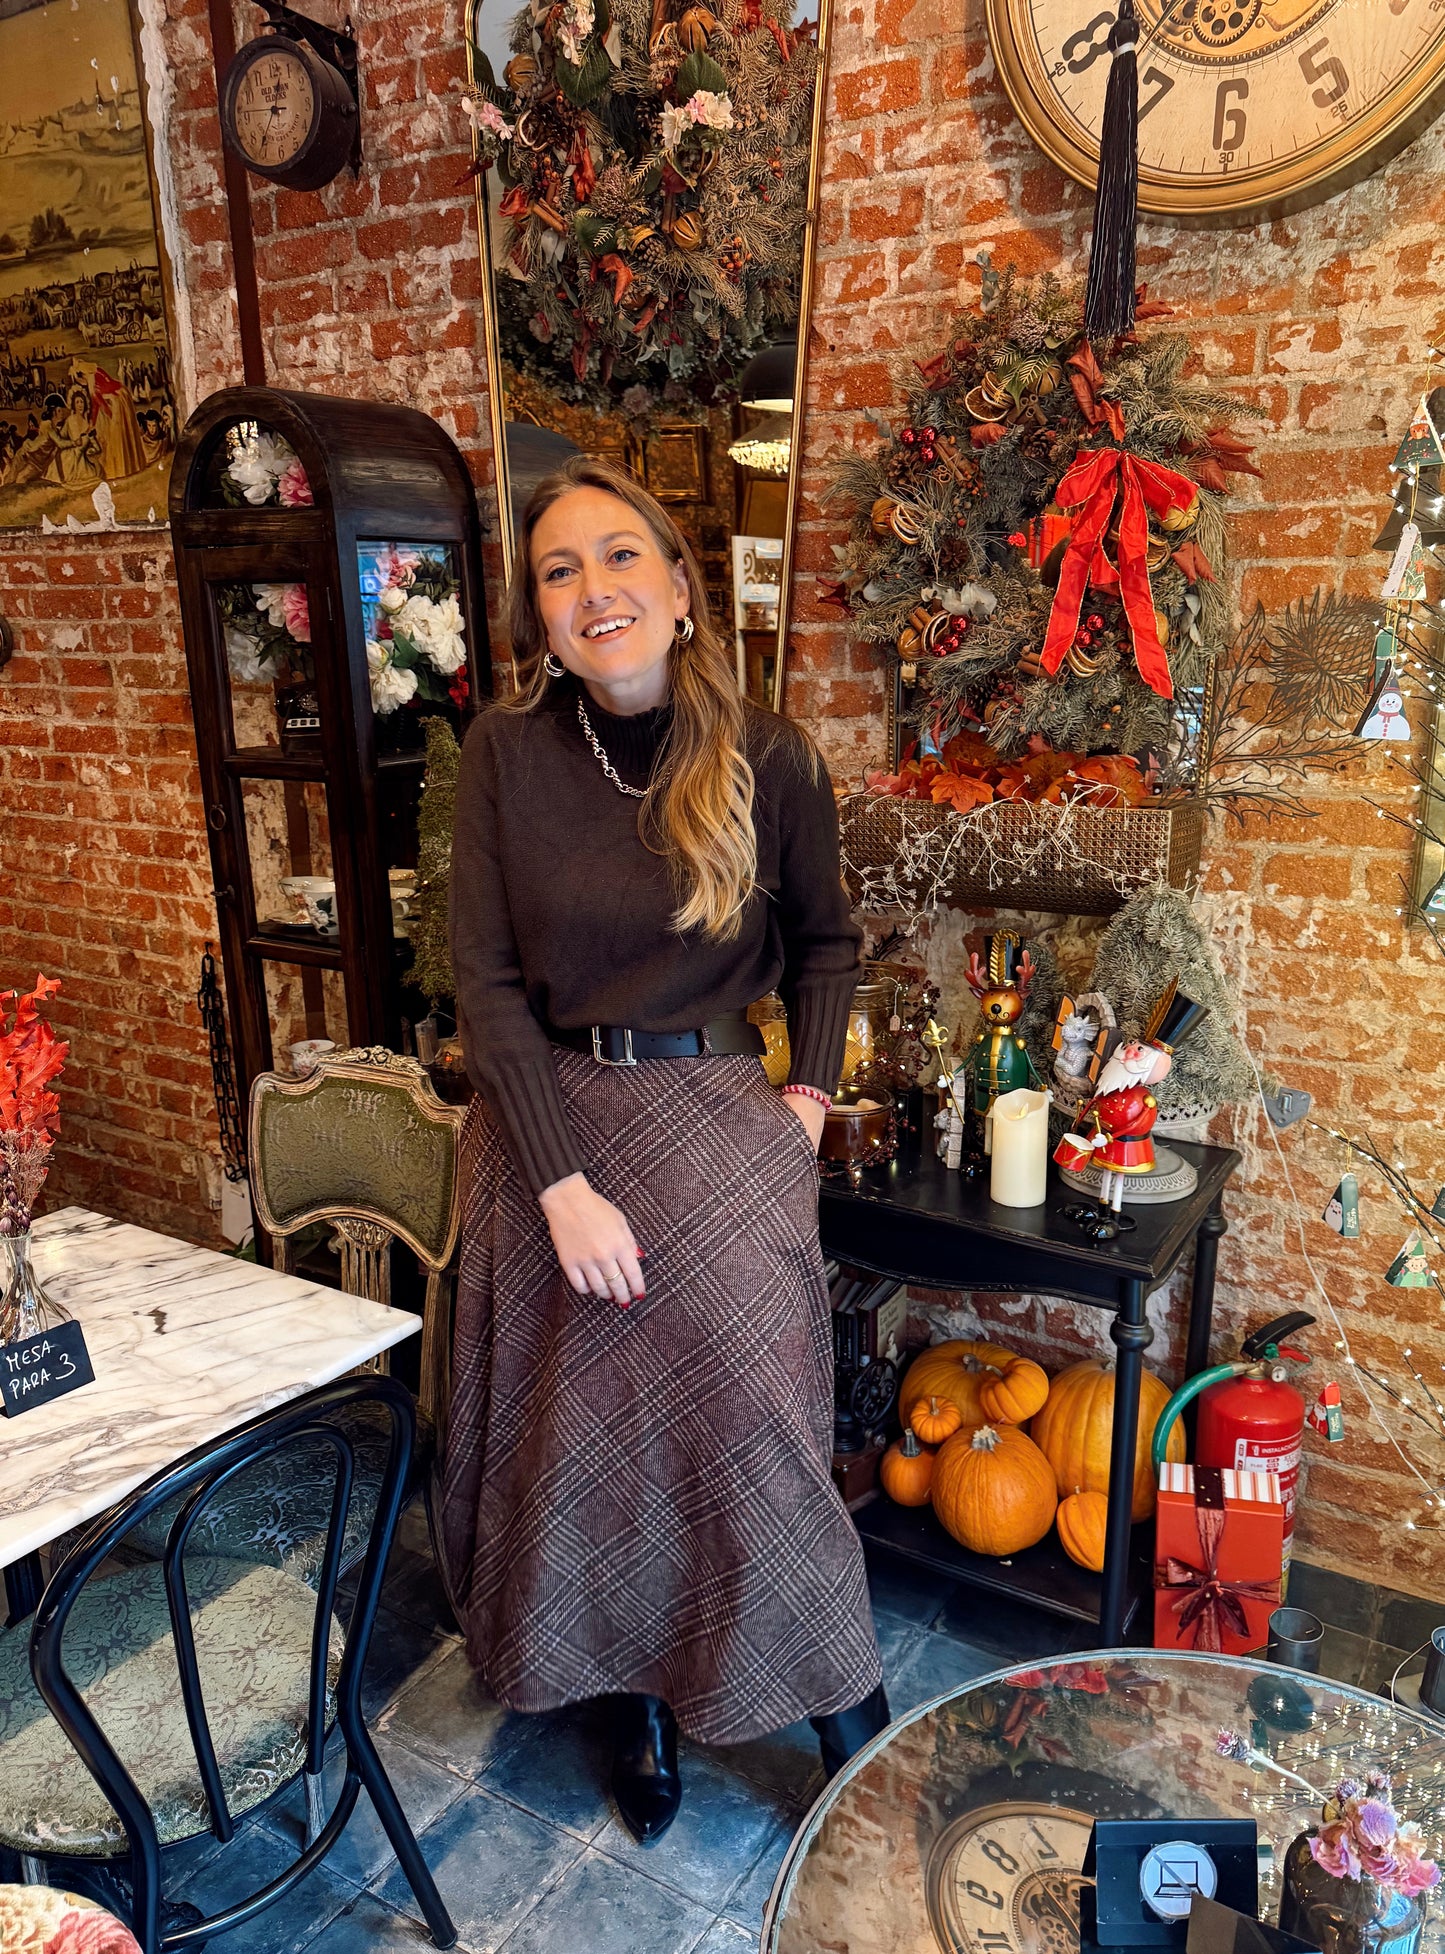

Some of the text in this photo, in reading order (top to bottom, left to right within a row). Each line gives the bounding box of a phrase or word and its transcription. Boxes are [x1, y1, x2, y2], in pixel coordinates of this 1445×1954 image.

[268, 61, 282, 78] 12
[286, 63, 291, 78] 1
[1053, 61, 1066, 77] 40
[1298, 36, 1350, 108] 5
[253, 70, 263, 86] 11
[298, 76, 305, 92] 2
[245, 88, 254, 105] 10
[261, 86, 272, 96] OLD
[305, 96, 312, 112] 3
[1330, 102, 1347, 117] 25
[243, 111, 251, 125] 9
[1212, 77, 1249, 150] 6
[250, 131, 257, 146] 8
[292, 137, 300, 151] 5
[278, 145, 285, 160] 6
[1218, 152, 1234, 163] 30
[6, 1340, 55, 1372] MESA
[9, 1353, 76, 1399] PARA 3
